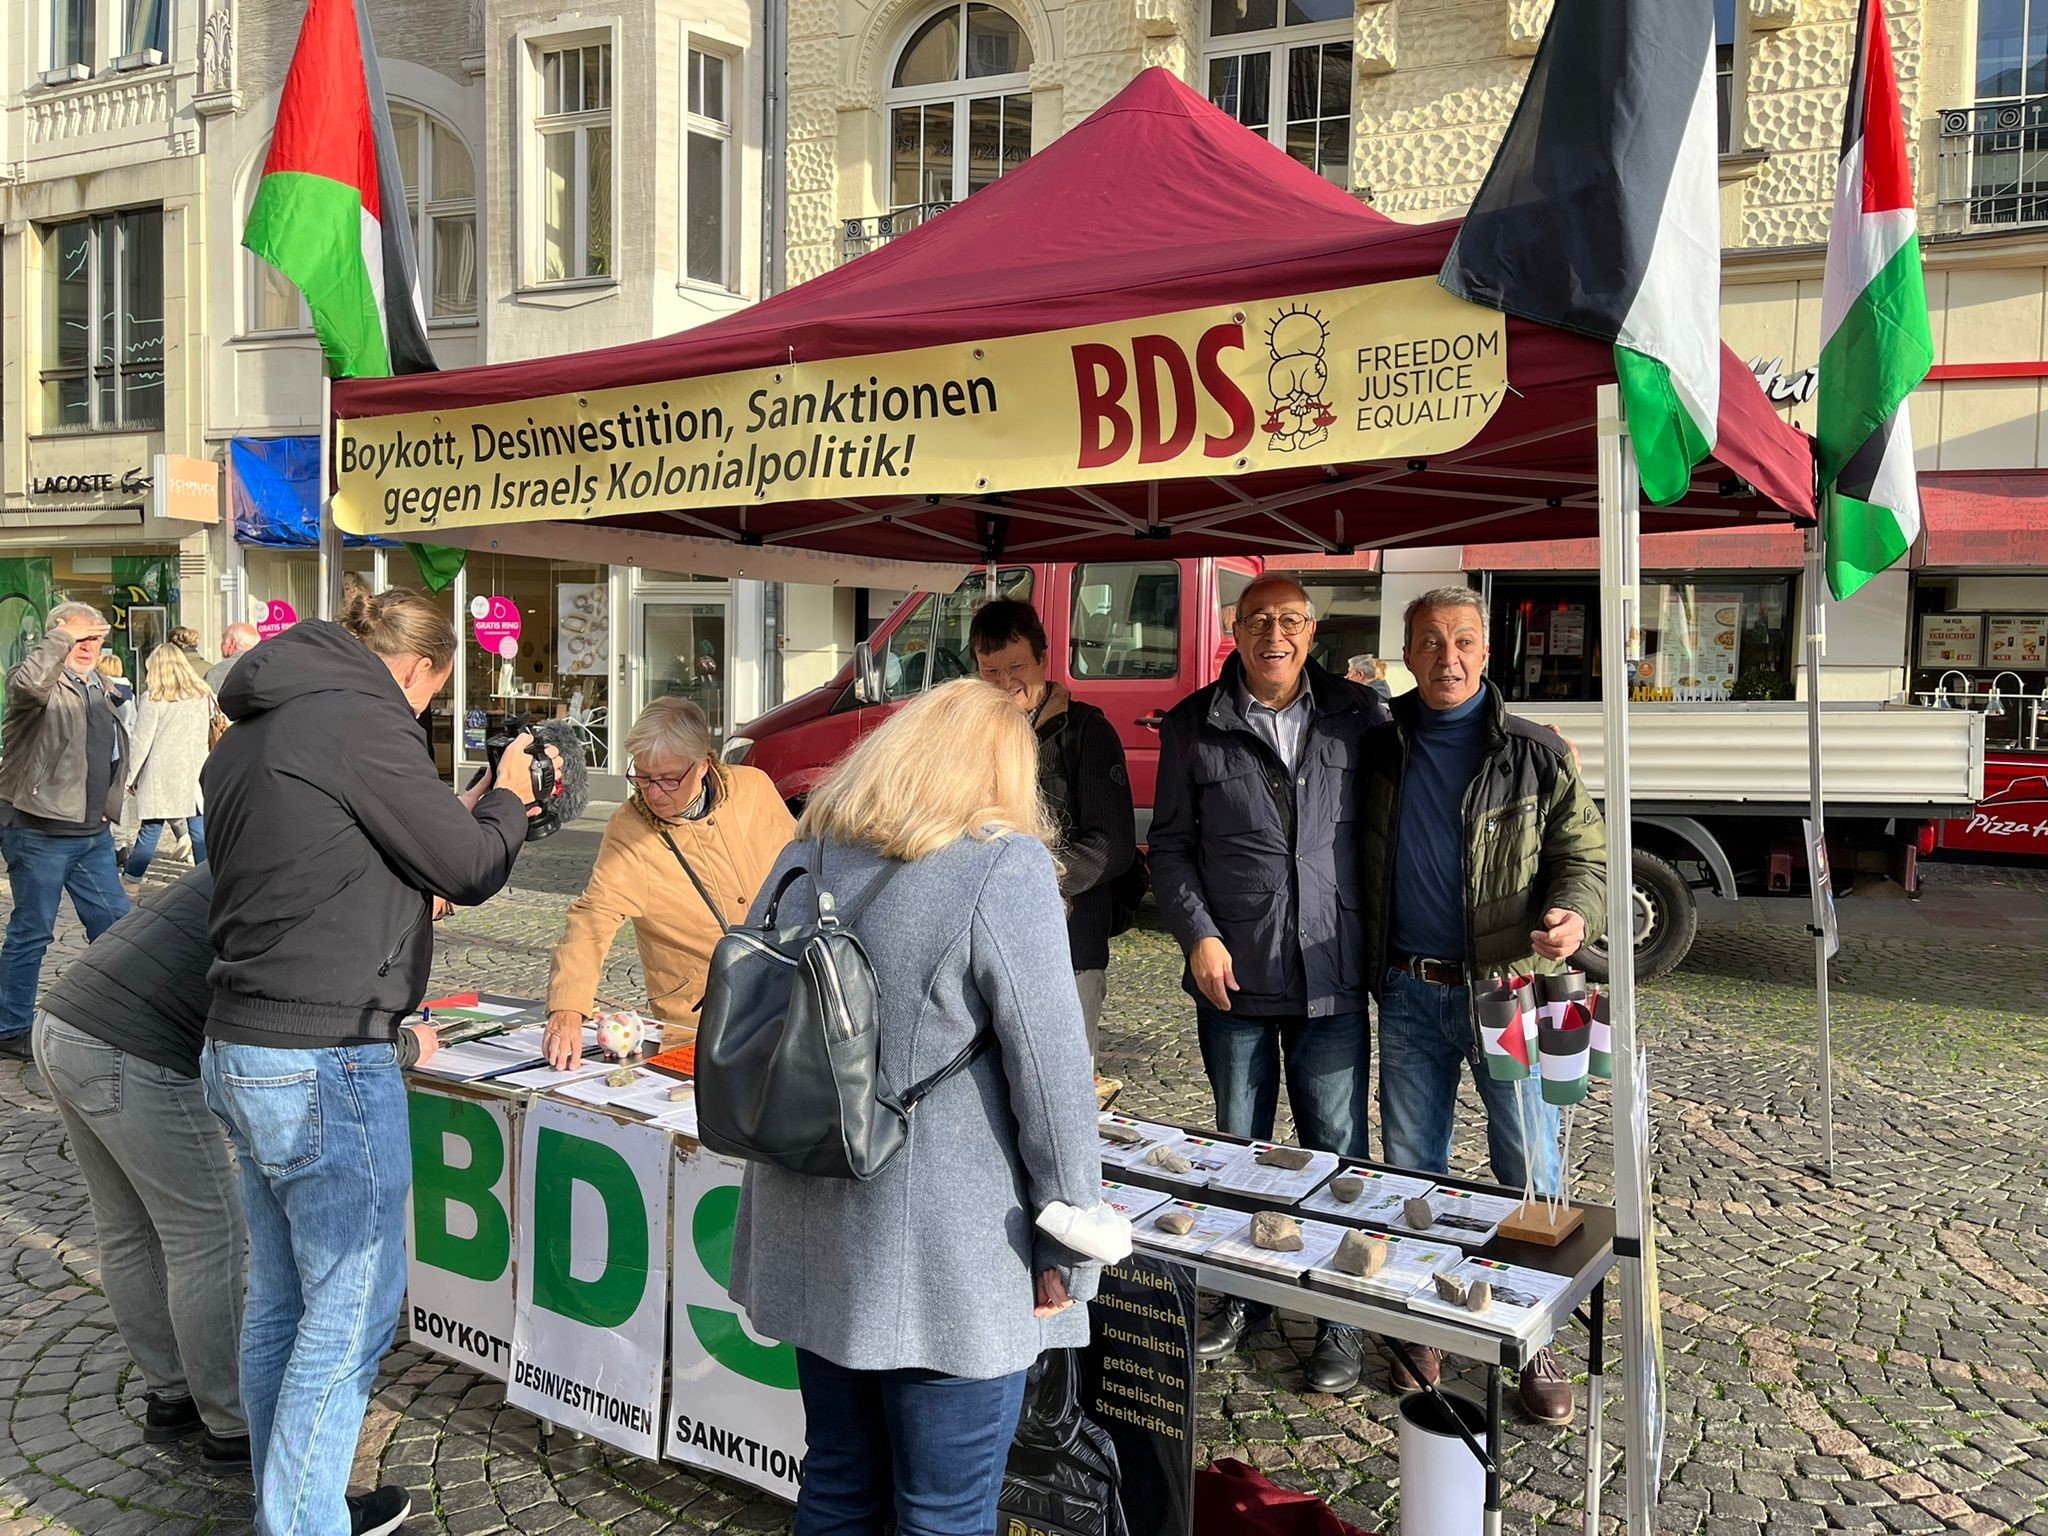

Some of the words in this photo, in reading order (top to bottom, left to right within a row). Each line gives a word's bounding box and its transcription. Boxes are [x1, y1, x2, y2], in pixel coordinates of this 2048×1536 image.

[1357, 330, 1499, 374] FREEDOM
[1071, 324, 1256, 469] BDS
[1357, 364, 1473, 402] JUSTICE
[340, 431, 464, 475] Boykott,
[473, 400, 733, 463] Desinvestition,
[746, 376, 998, 433] Sanktionen
[1356, 391, 1498, 431] EQUALITY
[34, 474, 114, 494] LACOSTE
[169, 478, 216, 494] SCHMUCK
[384, 482, 481, 525] gegen
[490, 468, 597, 510] Israels
[607, 435, 914, 501] Kolonialpolitik!
[258, 623, 280, 633] GRATIS
[476, 621, 500, 630] GRATIS
[502, 621, 519, 630] RING
[1965, 813, 2030, 835] Pizza
[407, 1088, 511, 1282] B
[532, 1126, 650, 1329] D
[1101, 1265, 1128, 1281] Abu
[1131, 1269, 1179, 1295] Akleh,
[1102, 1322, 1185, 1358] Journalistin
[1103, 1356, 1154, 1380] getötet
[1157, 1371, 1185, 1390] von
[514, 1360, 652, 1436] DESINVESTITIONEN
[1102, 1376, 1184, 1415] israelischen
[1095, 1398, 1184, 1440] Streitkräften
